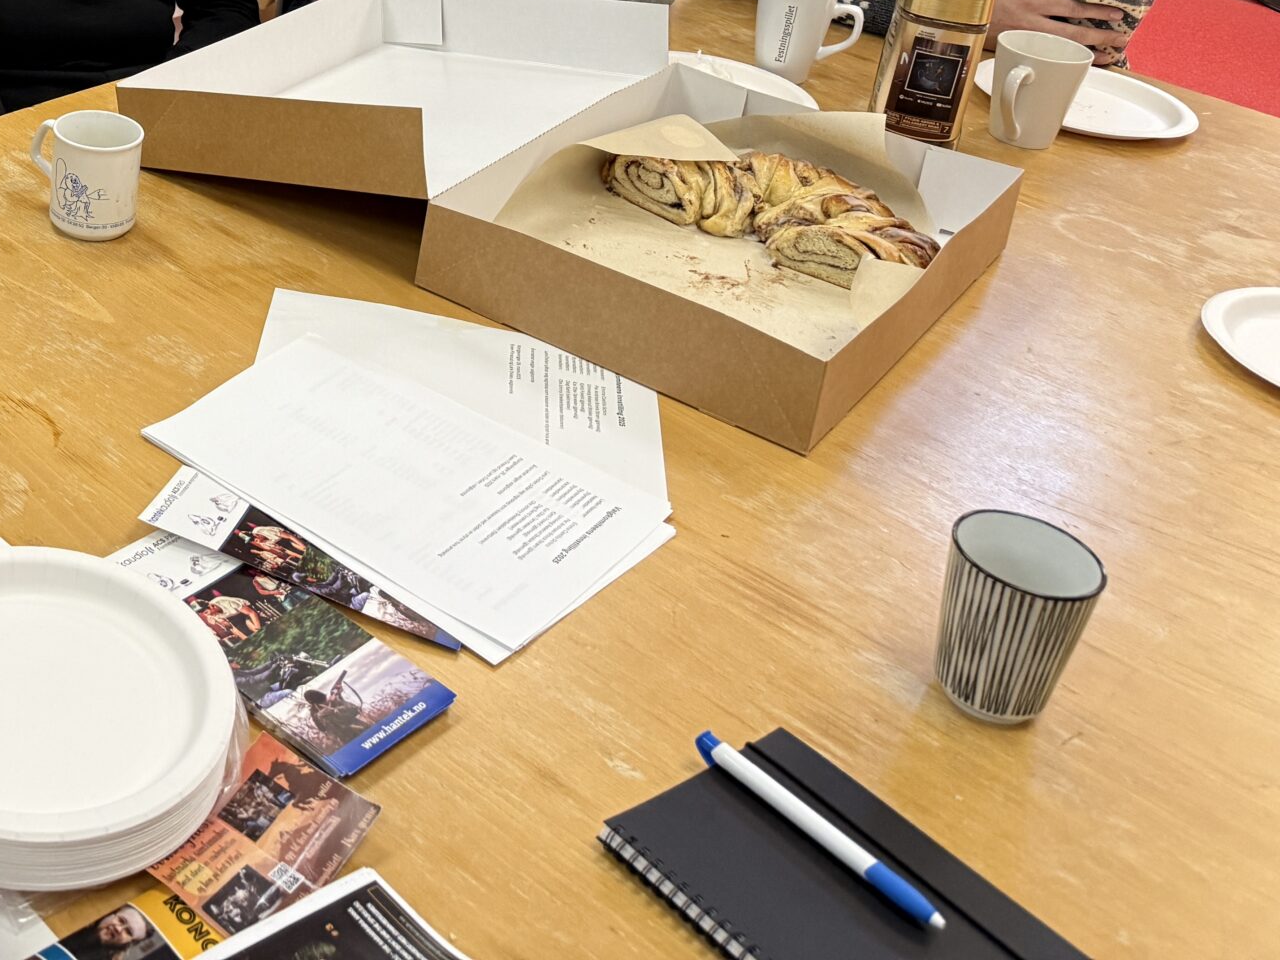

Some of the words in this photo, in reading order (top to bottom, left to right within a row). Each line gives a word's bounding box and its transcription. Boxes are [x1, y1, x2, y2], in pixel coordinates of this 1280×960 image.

[774, 5, 795, 63] Festningsspillet
[551, 550, 567, 564] 2025
[561, 534, 588, 554] innstilling
[361, 702, 426, 749] www.hantek.no
